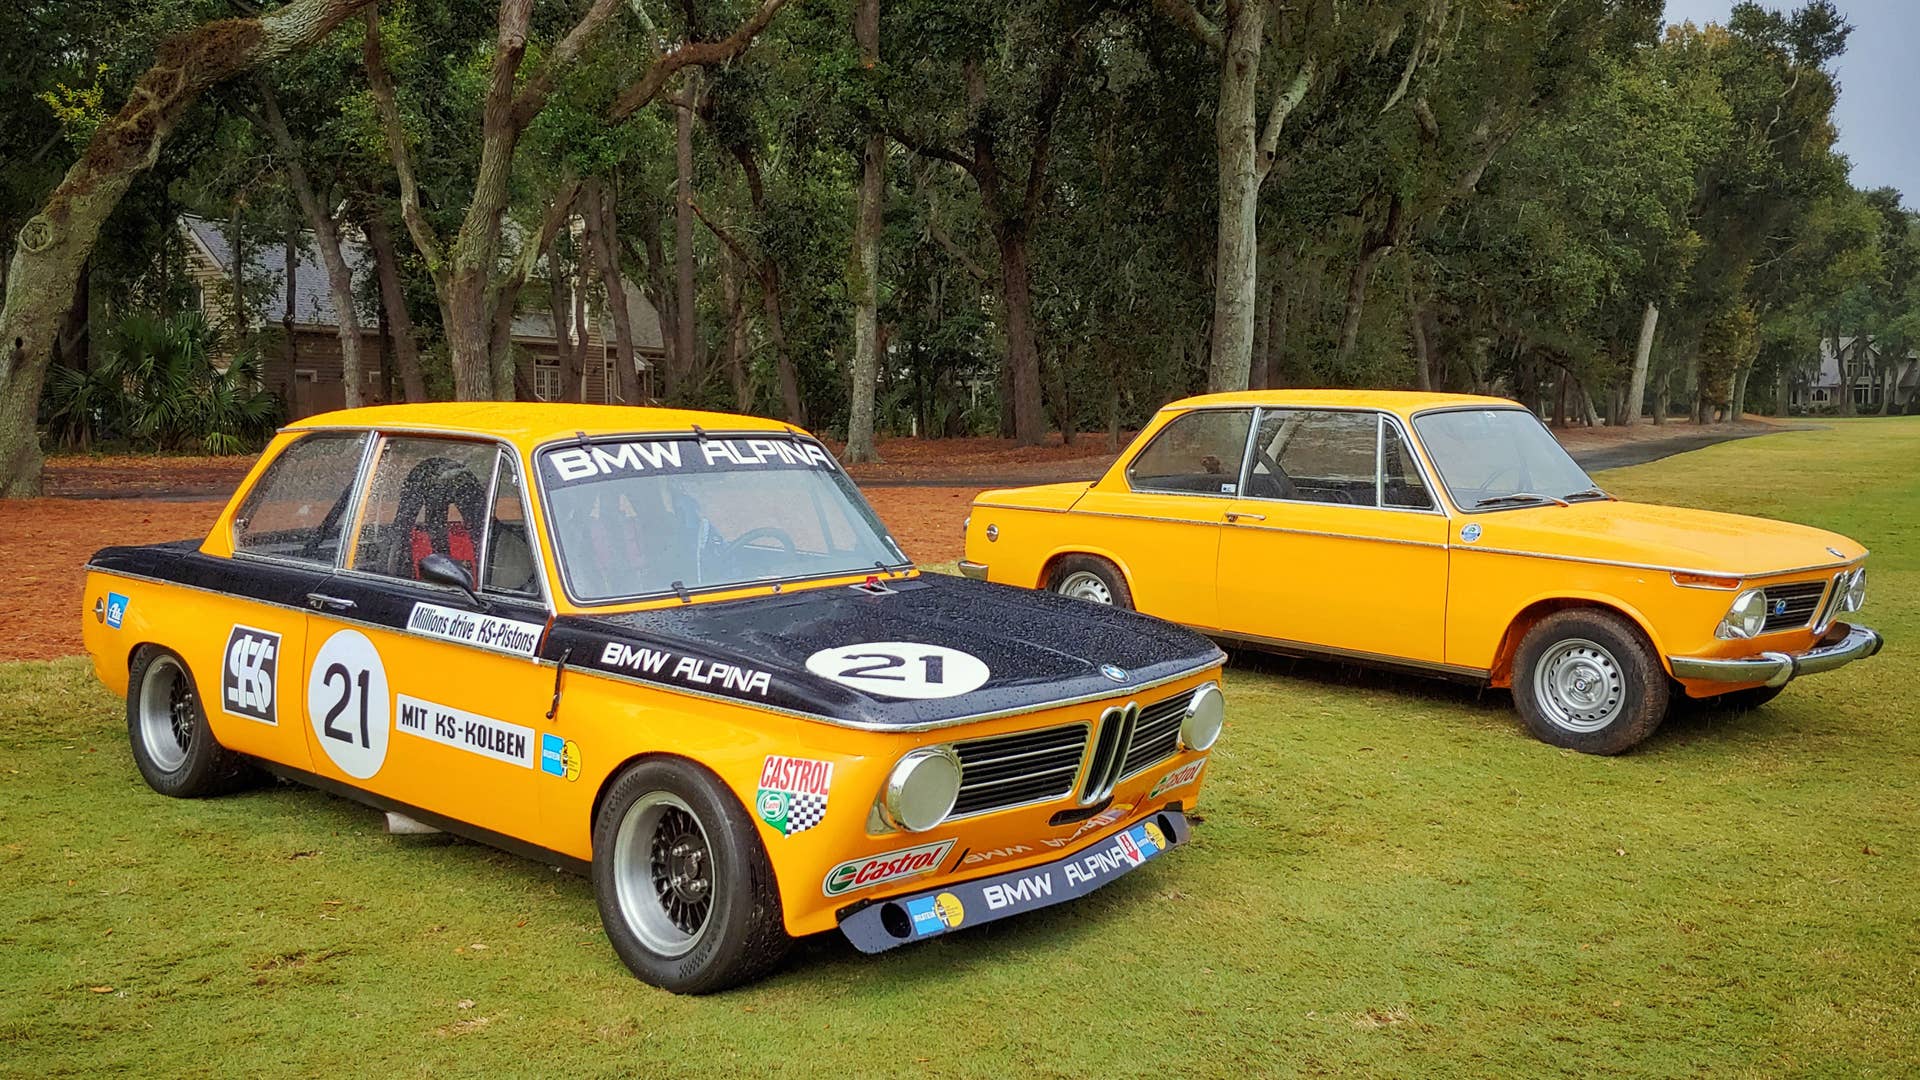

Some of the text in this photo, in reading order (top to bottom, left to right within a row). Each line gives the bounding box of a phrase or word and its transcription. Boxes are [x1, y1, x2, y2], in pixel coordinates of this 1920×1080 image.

[549, 438, 836, 482] BMW ALPINA
[410, 606, 536, 653] Millions drive KS-Pistons
[600, 642, 772, 696] BMW ALPINA
[838, 653, 944, 684] 21
[323, 662, 370, 749] 21
[401, 703, 526, 759] MIT KS-KOLBEN
[760, 756, 829, 795] CASTROL
[855, 846, 943, 885] Castrol
[983, 845, 1130, 911] BMW ALPINA
